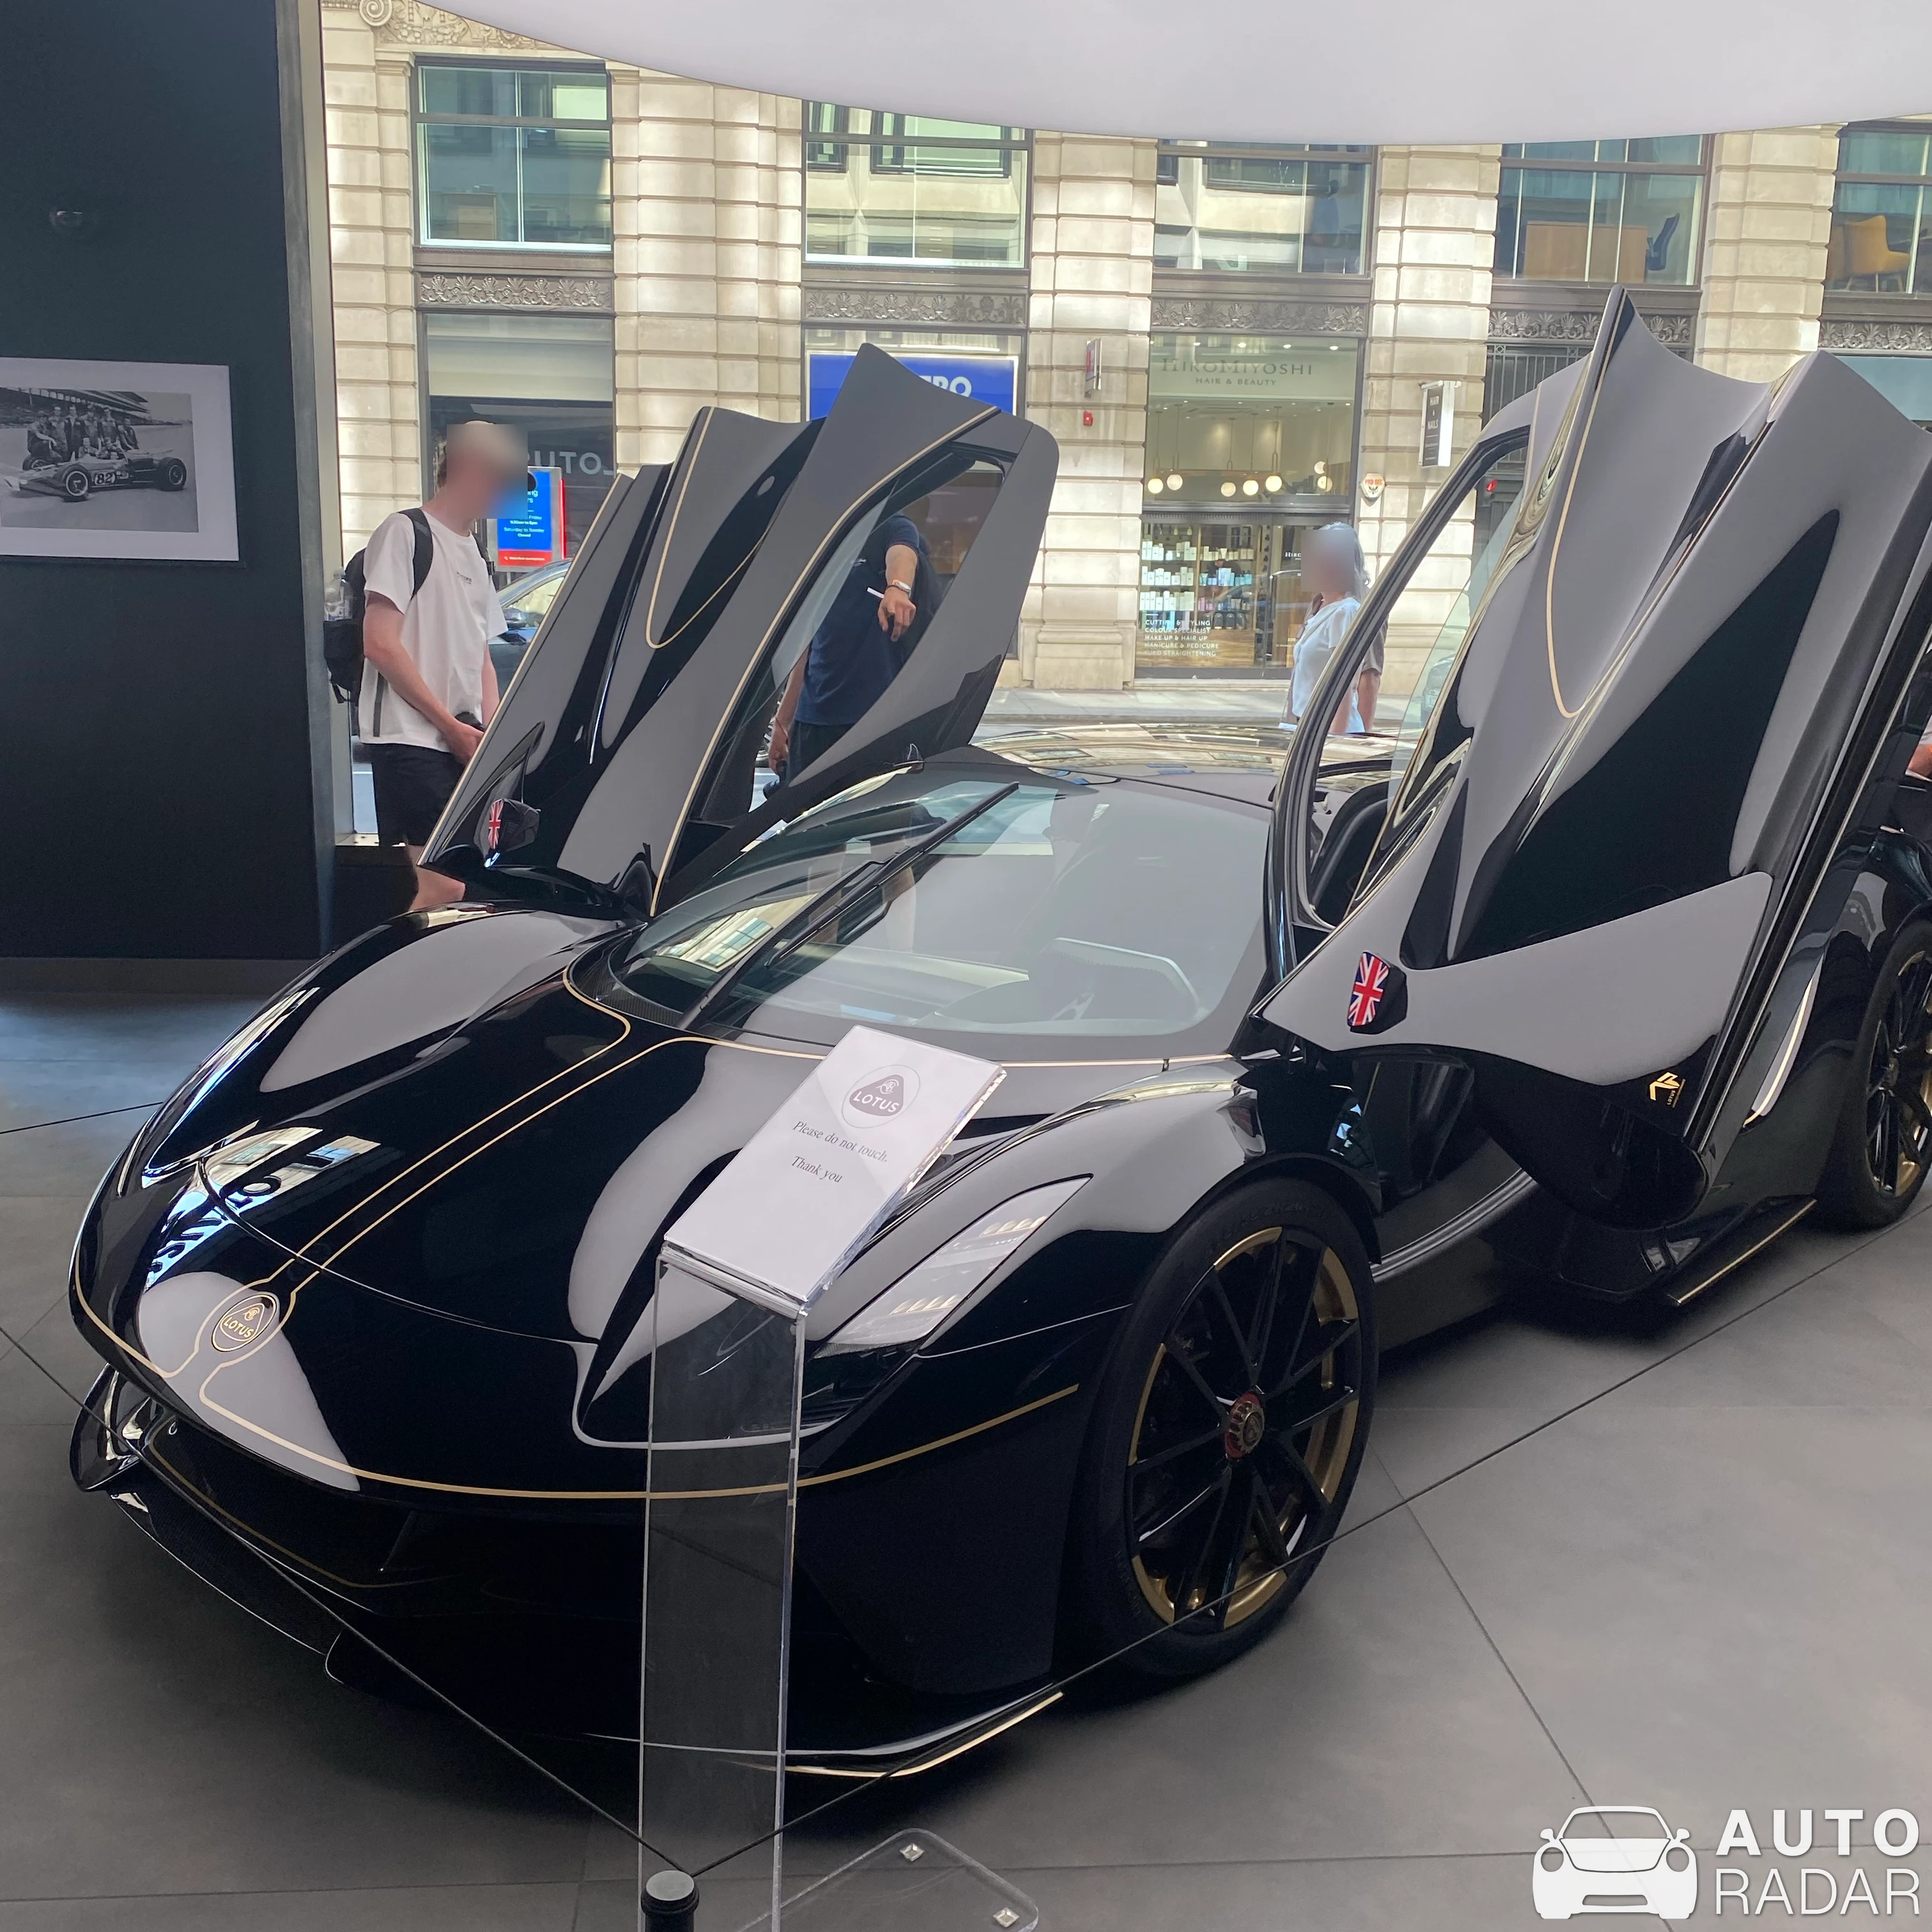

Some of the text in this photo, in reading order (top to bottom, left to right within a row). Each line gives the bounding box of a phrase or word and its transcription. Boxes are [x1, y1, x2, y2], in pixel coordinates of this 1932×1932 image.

[1429, 395, 1439, 406] HAIR
[96, 472, 113, 484] 82
[853, 1091, 900, 1112] LOTUS
[792, 1121, 887, 1162] Please do not touch.
[791, 1156, 843, 1183] Thank you
[224, 1317, 254, 1338] LOTUS
